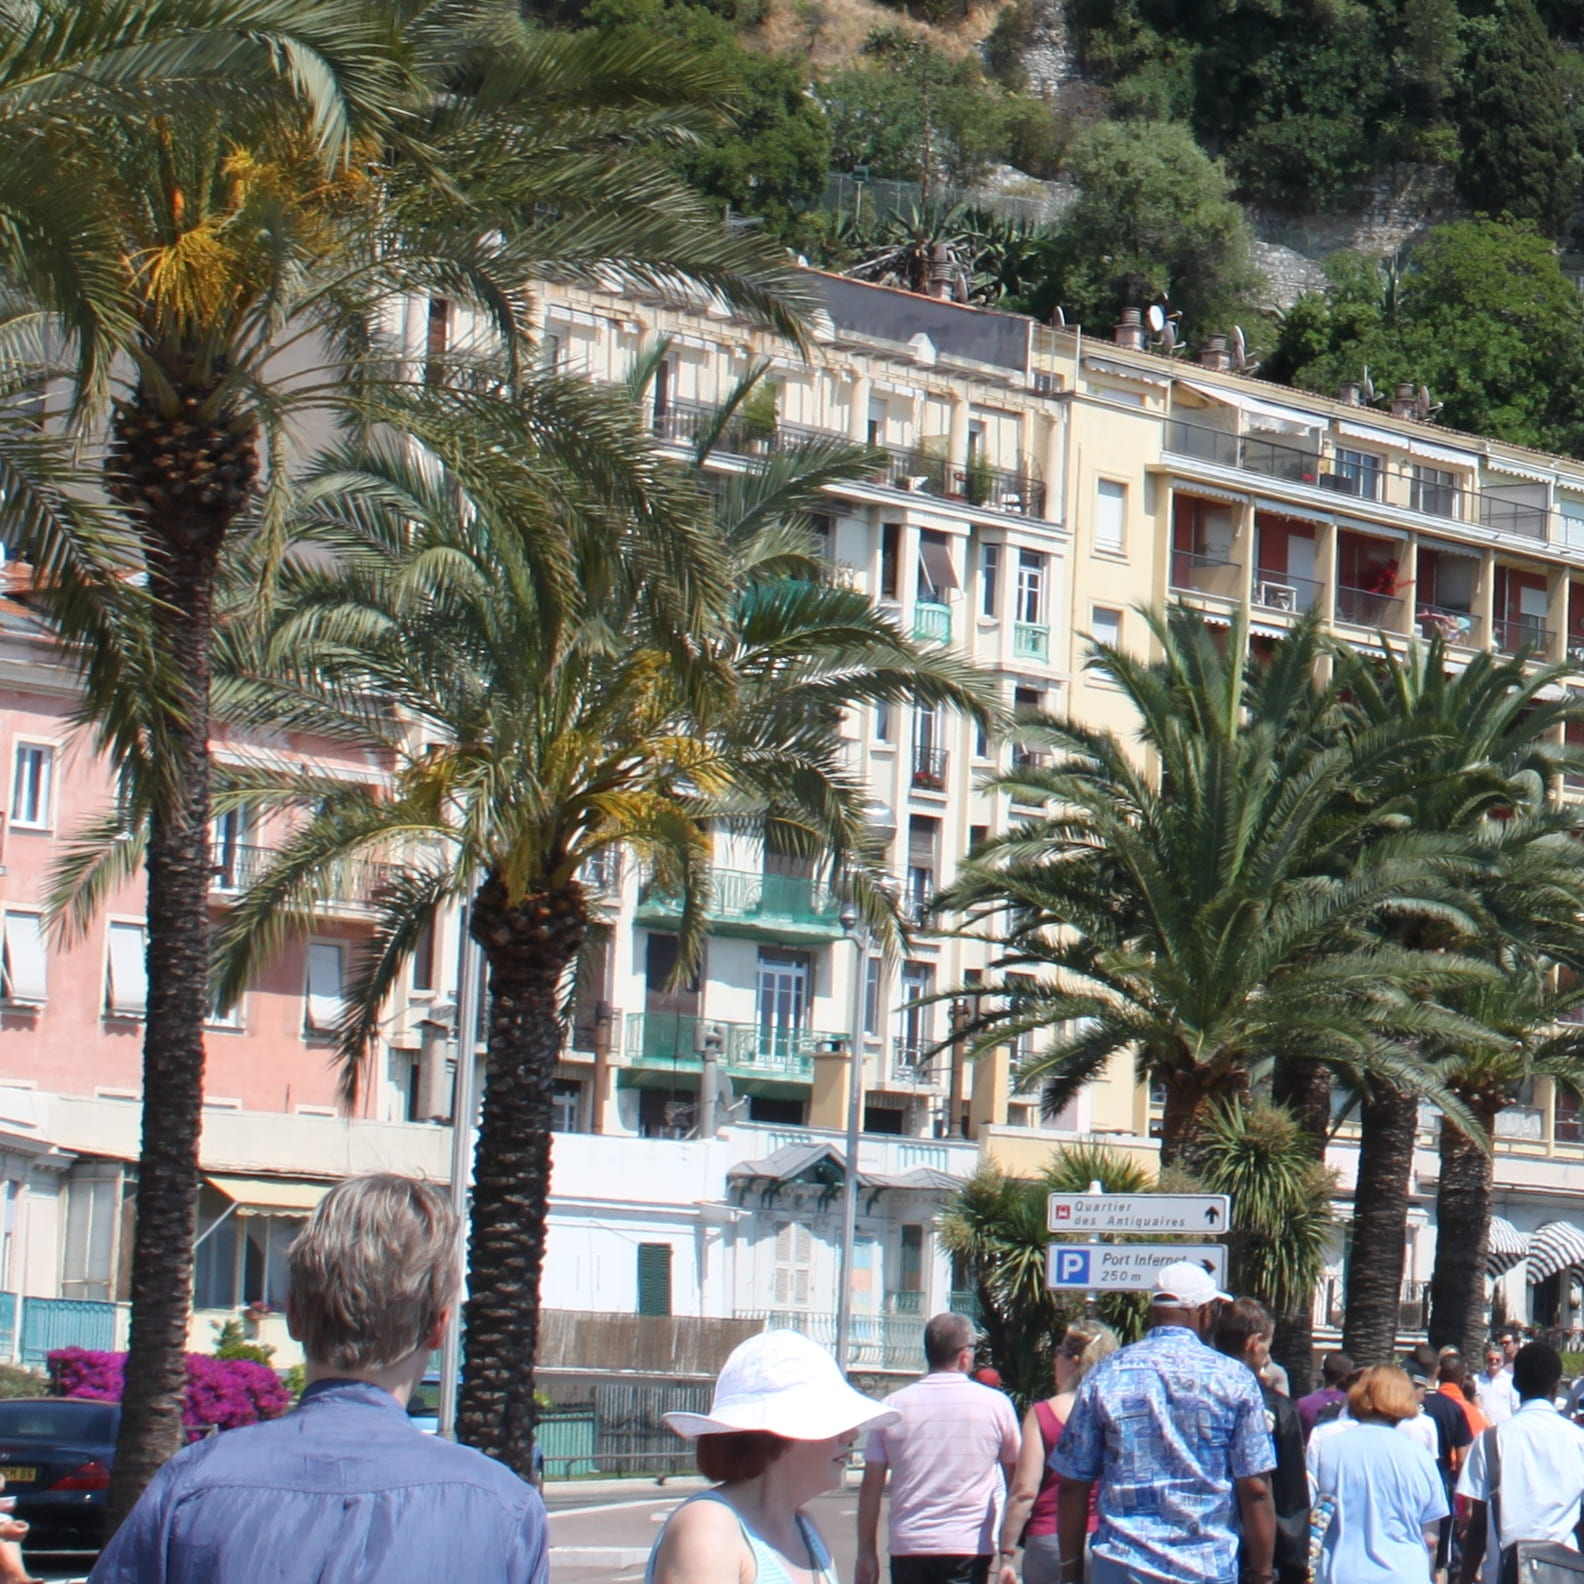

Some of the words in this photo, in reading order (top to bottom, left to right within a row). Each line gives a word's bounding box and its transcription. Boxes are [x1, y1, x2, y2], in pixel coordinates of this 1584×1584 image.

[1074, 1200, 1133, 1212] Quartier
[1074, 1216, 1097, 1226] des
[1107, 1217, 1186, 1228] Antiquaires
[1102, 1253, 1131, 1266] Port
[1101, 1270, 1128, 1282] 250
[1130, 1273, 1141, 1281] m
